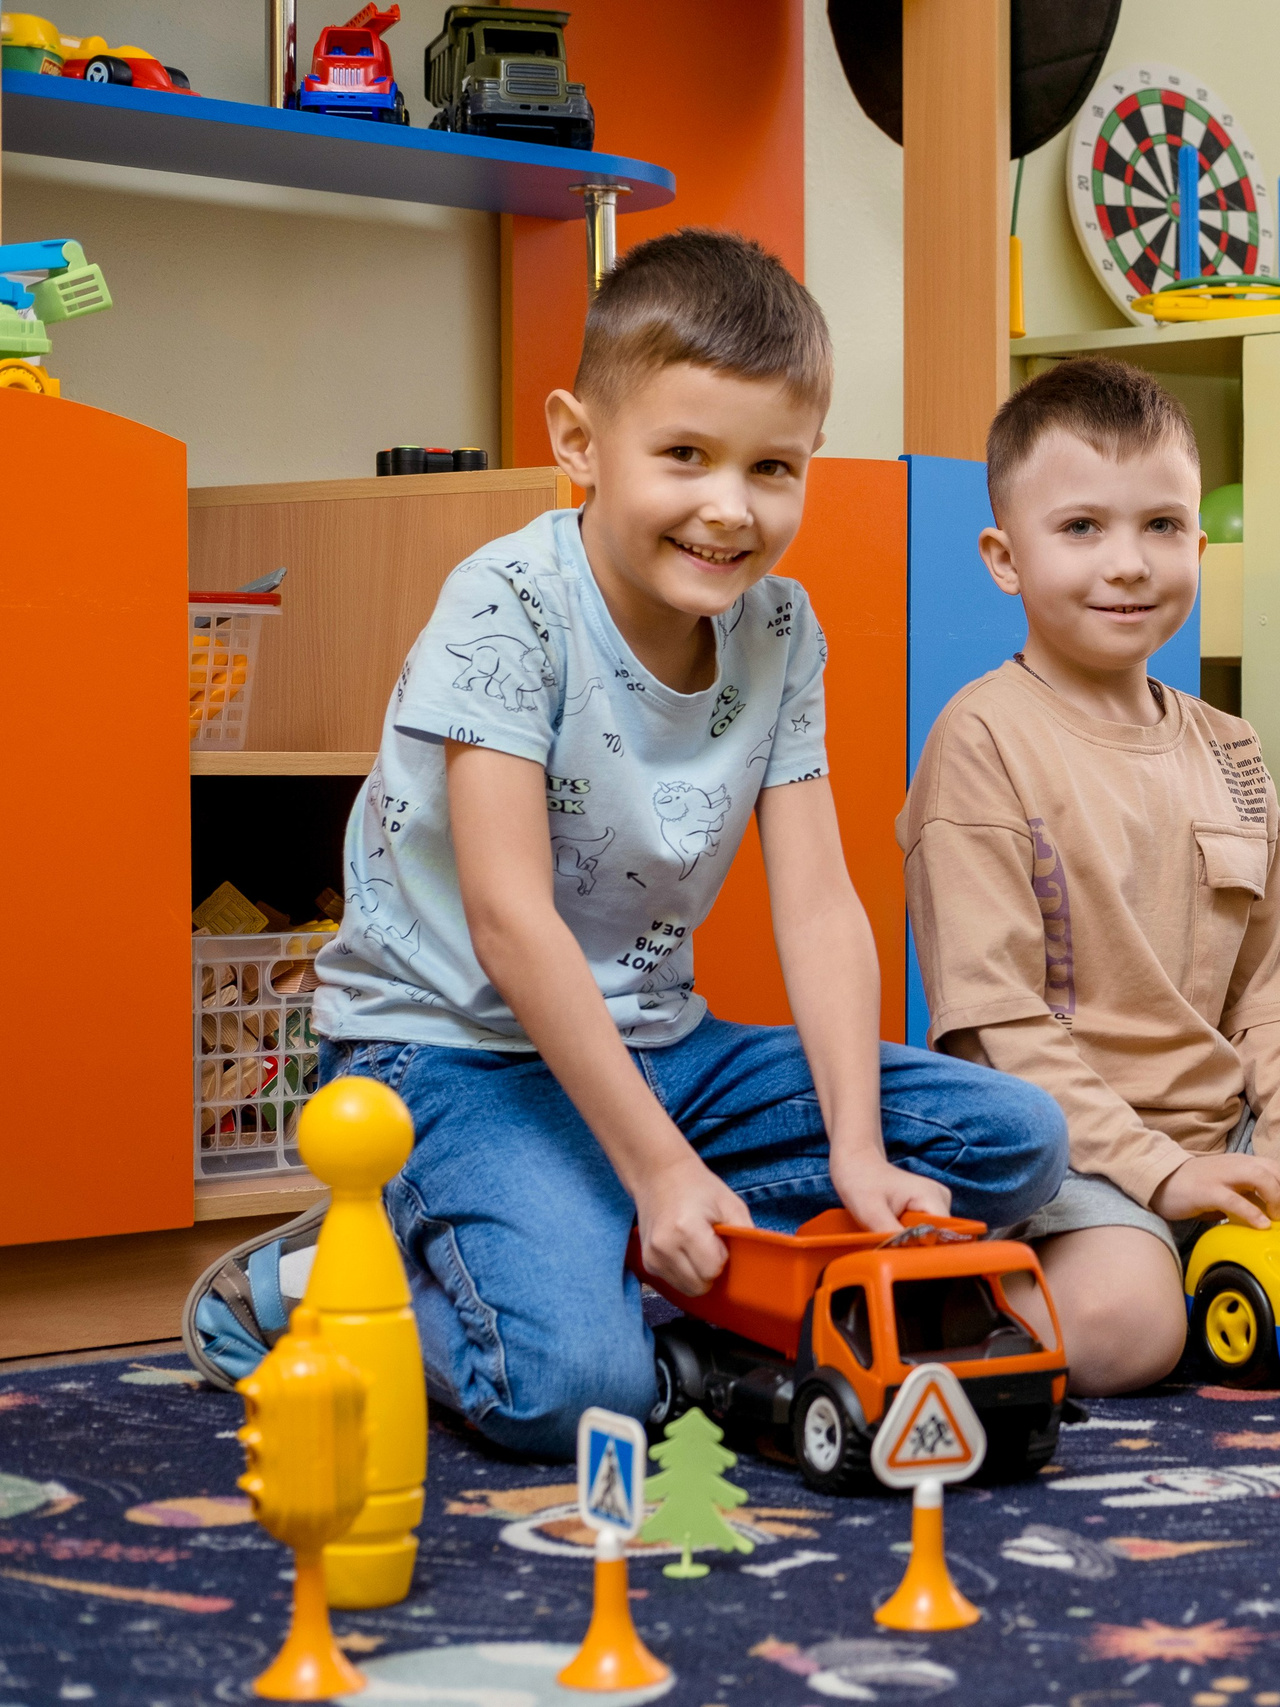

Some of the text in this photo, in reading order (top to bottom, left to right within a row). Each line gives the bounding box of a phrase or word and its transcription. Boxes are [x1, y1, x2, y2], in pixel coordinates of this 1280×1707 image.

[1113, 84, 1125, 94] 4
[1077, 175, 1089, 191] 20
[1255, 184, 1267, 197] 17
[1086, 222, 1097, 231] 5
[1102, 259, 1114, 271] 12
[1232, 738, 1252, 749] points
[1236, 759, 1252, 768] auto
[1242, 767, 1260, 777] races
[547, 775, 591, 794] T'S
[1239, 778, 1255, 788] sport
[547, 796, 586, 815] OK
[651, 920, 687, 938] DEA
[635, 937, 673, 956] UMB
[616, 952, 658, 975] NOT
